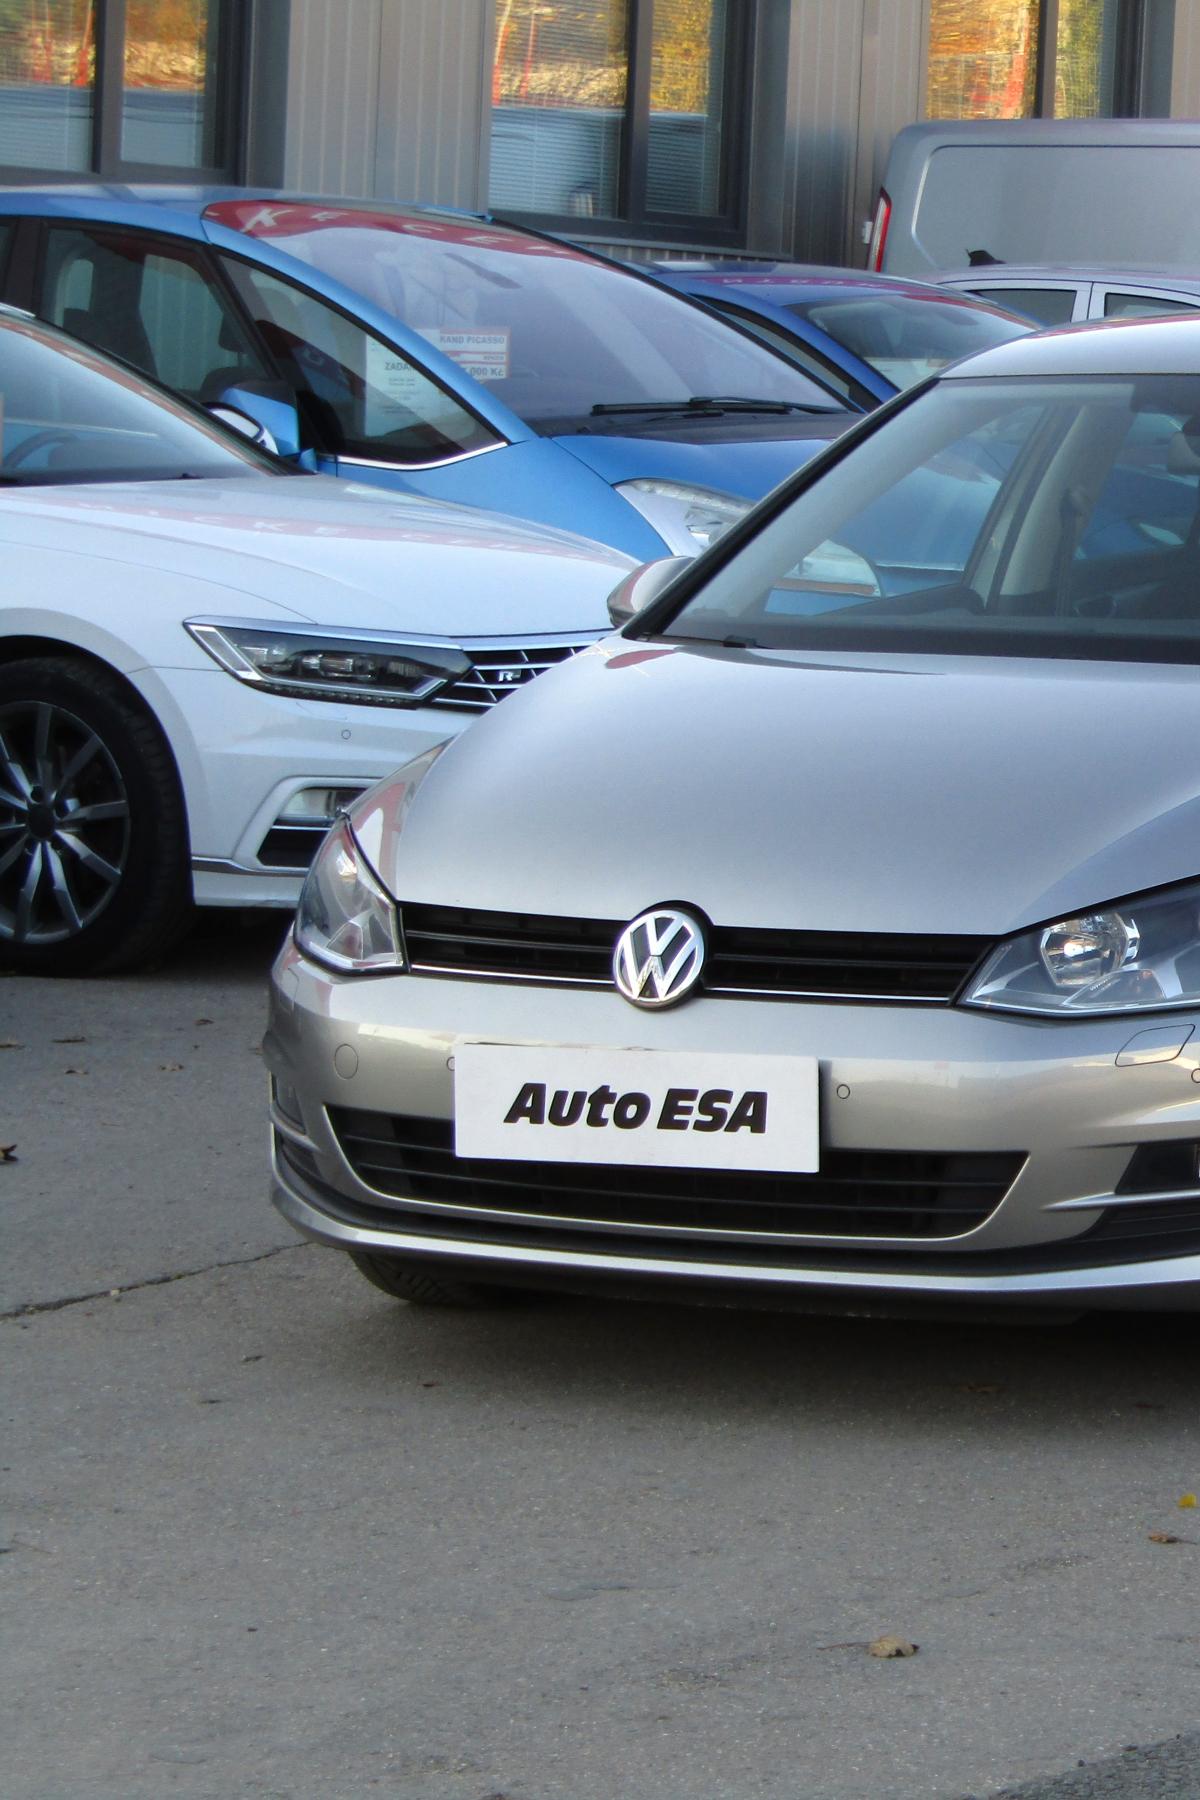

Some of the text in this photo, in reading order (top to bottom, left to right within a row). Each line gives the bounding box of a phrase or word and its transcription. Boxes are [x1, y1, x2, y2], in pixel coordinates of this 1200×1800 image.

[467, 335, 505, 344] PICASSO
[503, 1082, 768, 1134] Auto ESA
